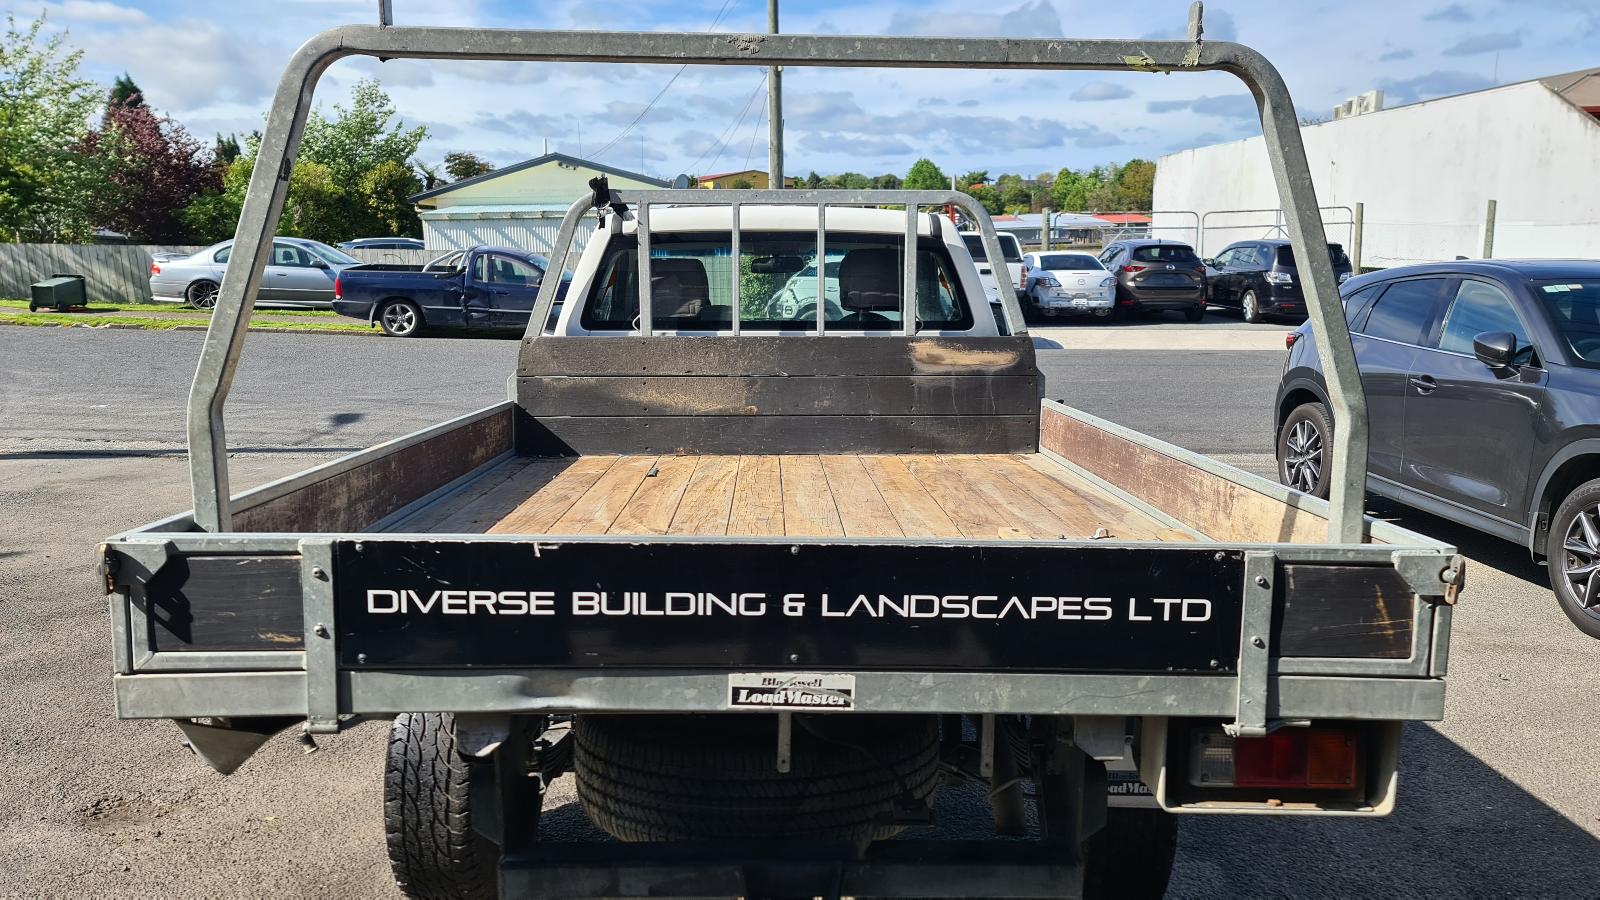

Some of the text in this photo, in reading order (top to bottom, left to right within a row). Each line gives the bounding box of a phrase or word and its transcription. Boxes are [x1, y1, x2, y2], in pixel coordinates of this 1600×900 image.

[366, 589, 1213, 622] DIVERSE BUILDING & LANDSCAPES LTD
[761, 677, 824, 688] Blakwell
[737, 688, 846, 706] LoadMaster
